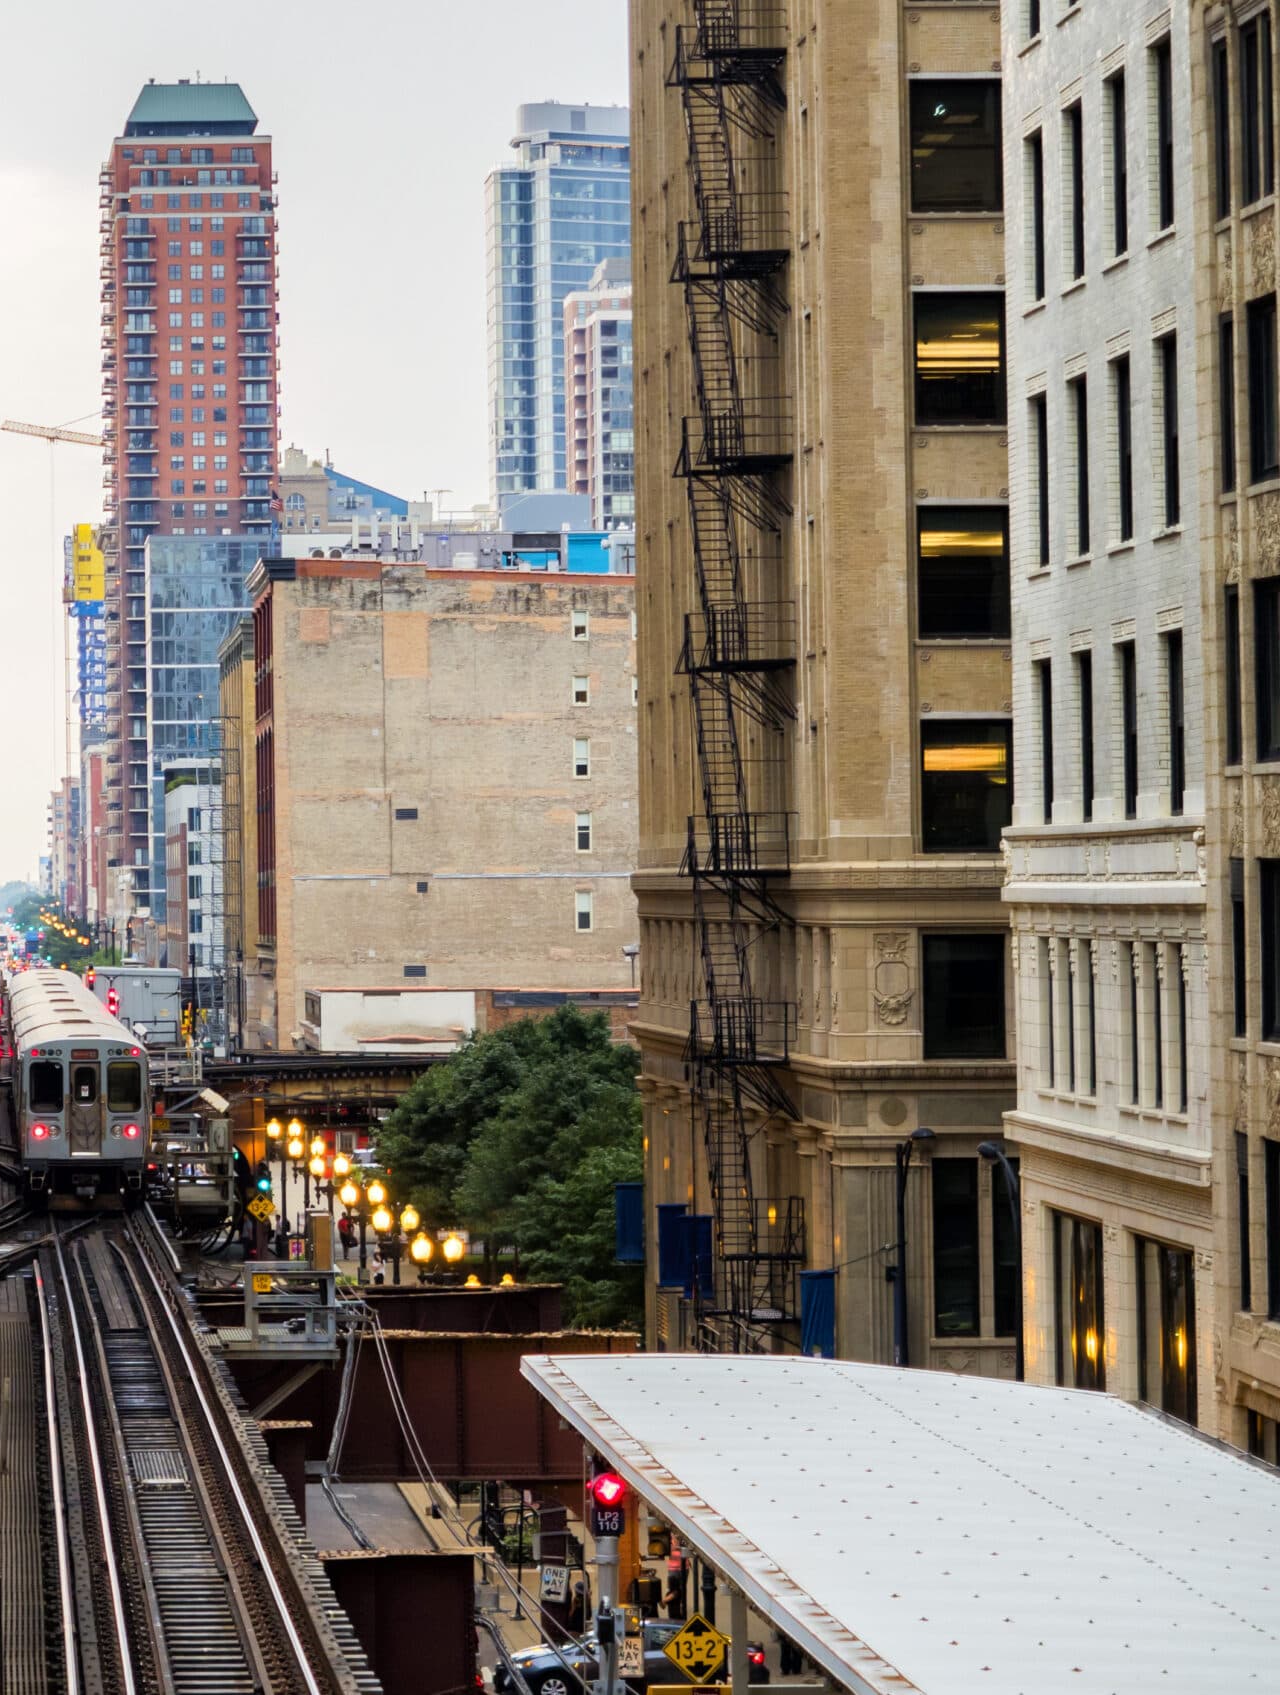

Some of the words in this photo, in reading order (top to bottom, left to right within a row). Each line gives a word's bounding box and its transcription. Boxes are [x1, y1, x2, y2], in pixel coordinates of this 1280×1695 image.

[597, 1511, 619, 1521] LP2
[598, 1521, 619, 1531] 110
[545, 1567, 565, 1578] ONE
